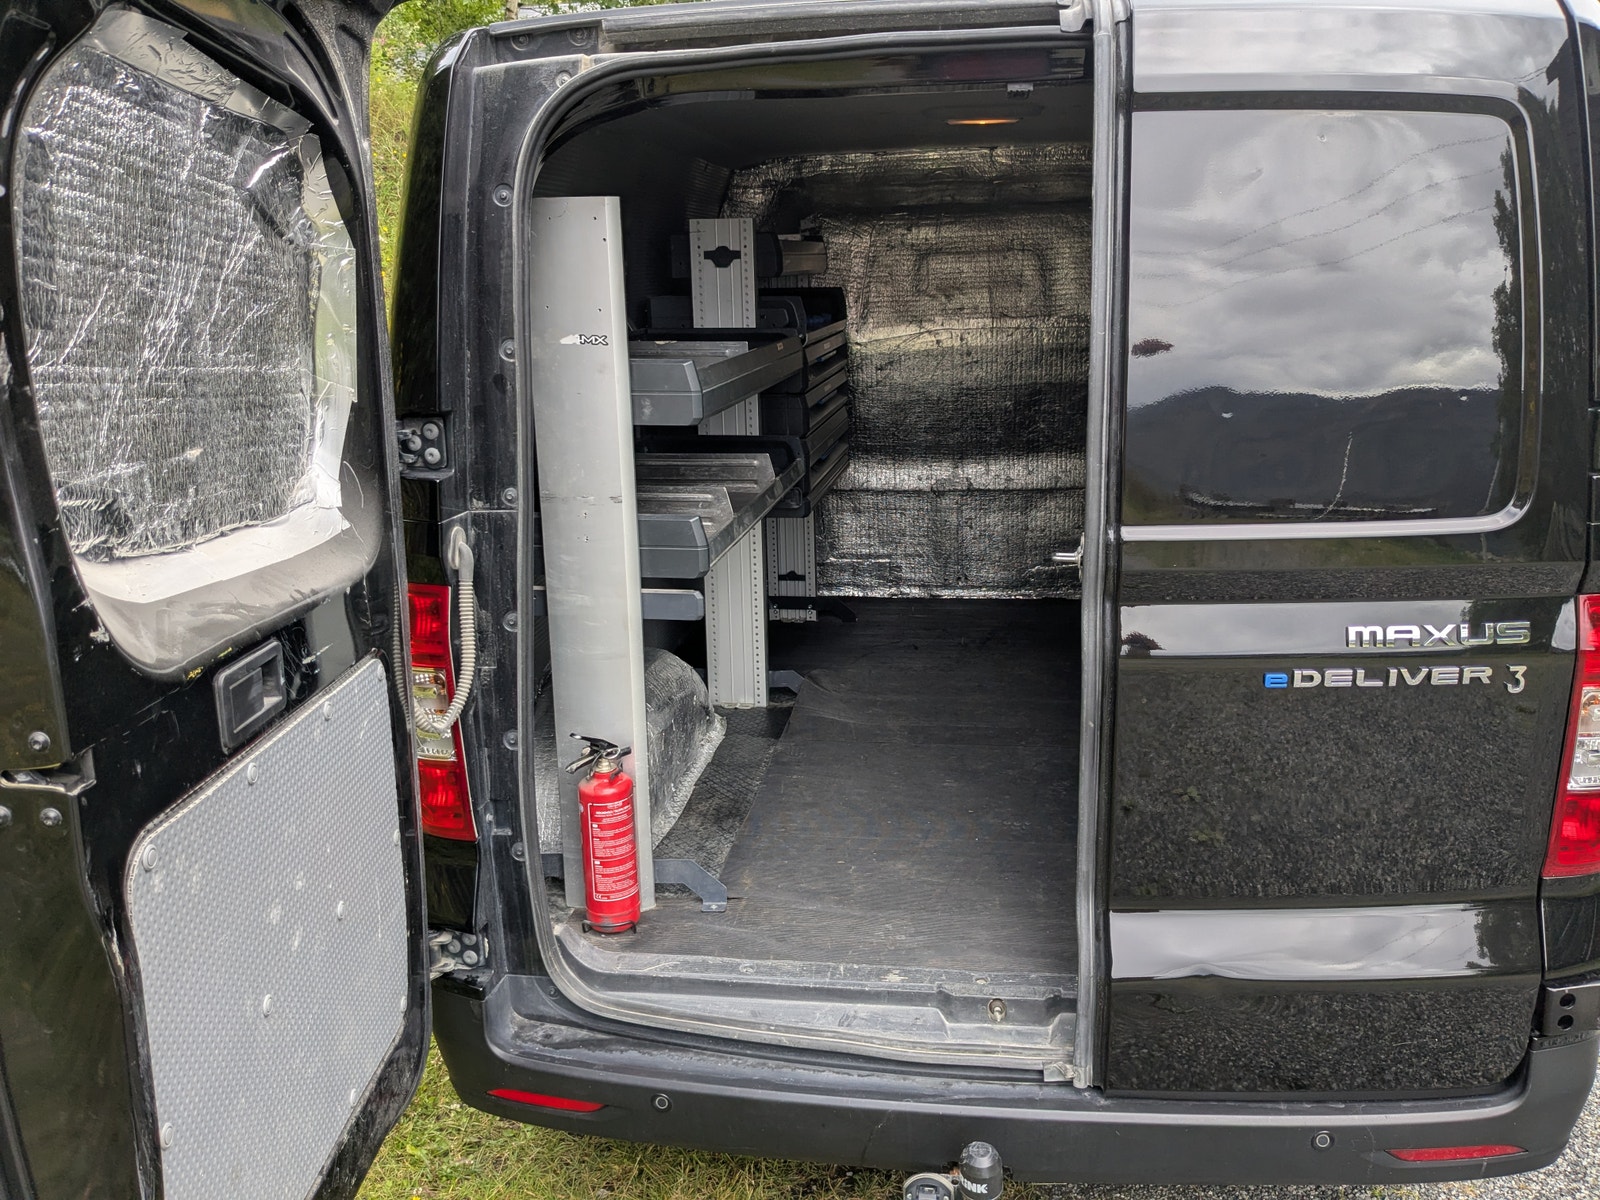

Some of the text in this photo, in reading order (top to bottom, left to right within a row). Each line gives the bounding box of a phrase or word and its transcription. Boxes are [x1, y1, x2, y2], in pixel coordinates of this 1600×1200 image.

[1346, 621, 1531, 648] MAXUS
[1263, 663, 1528, 694] eDELIVER 3
